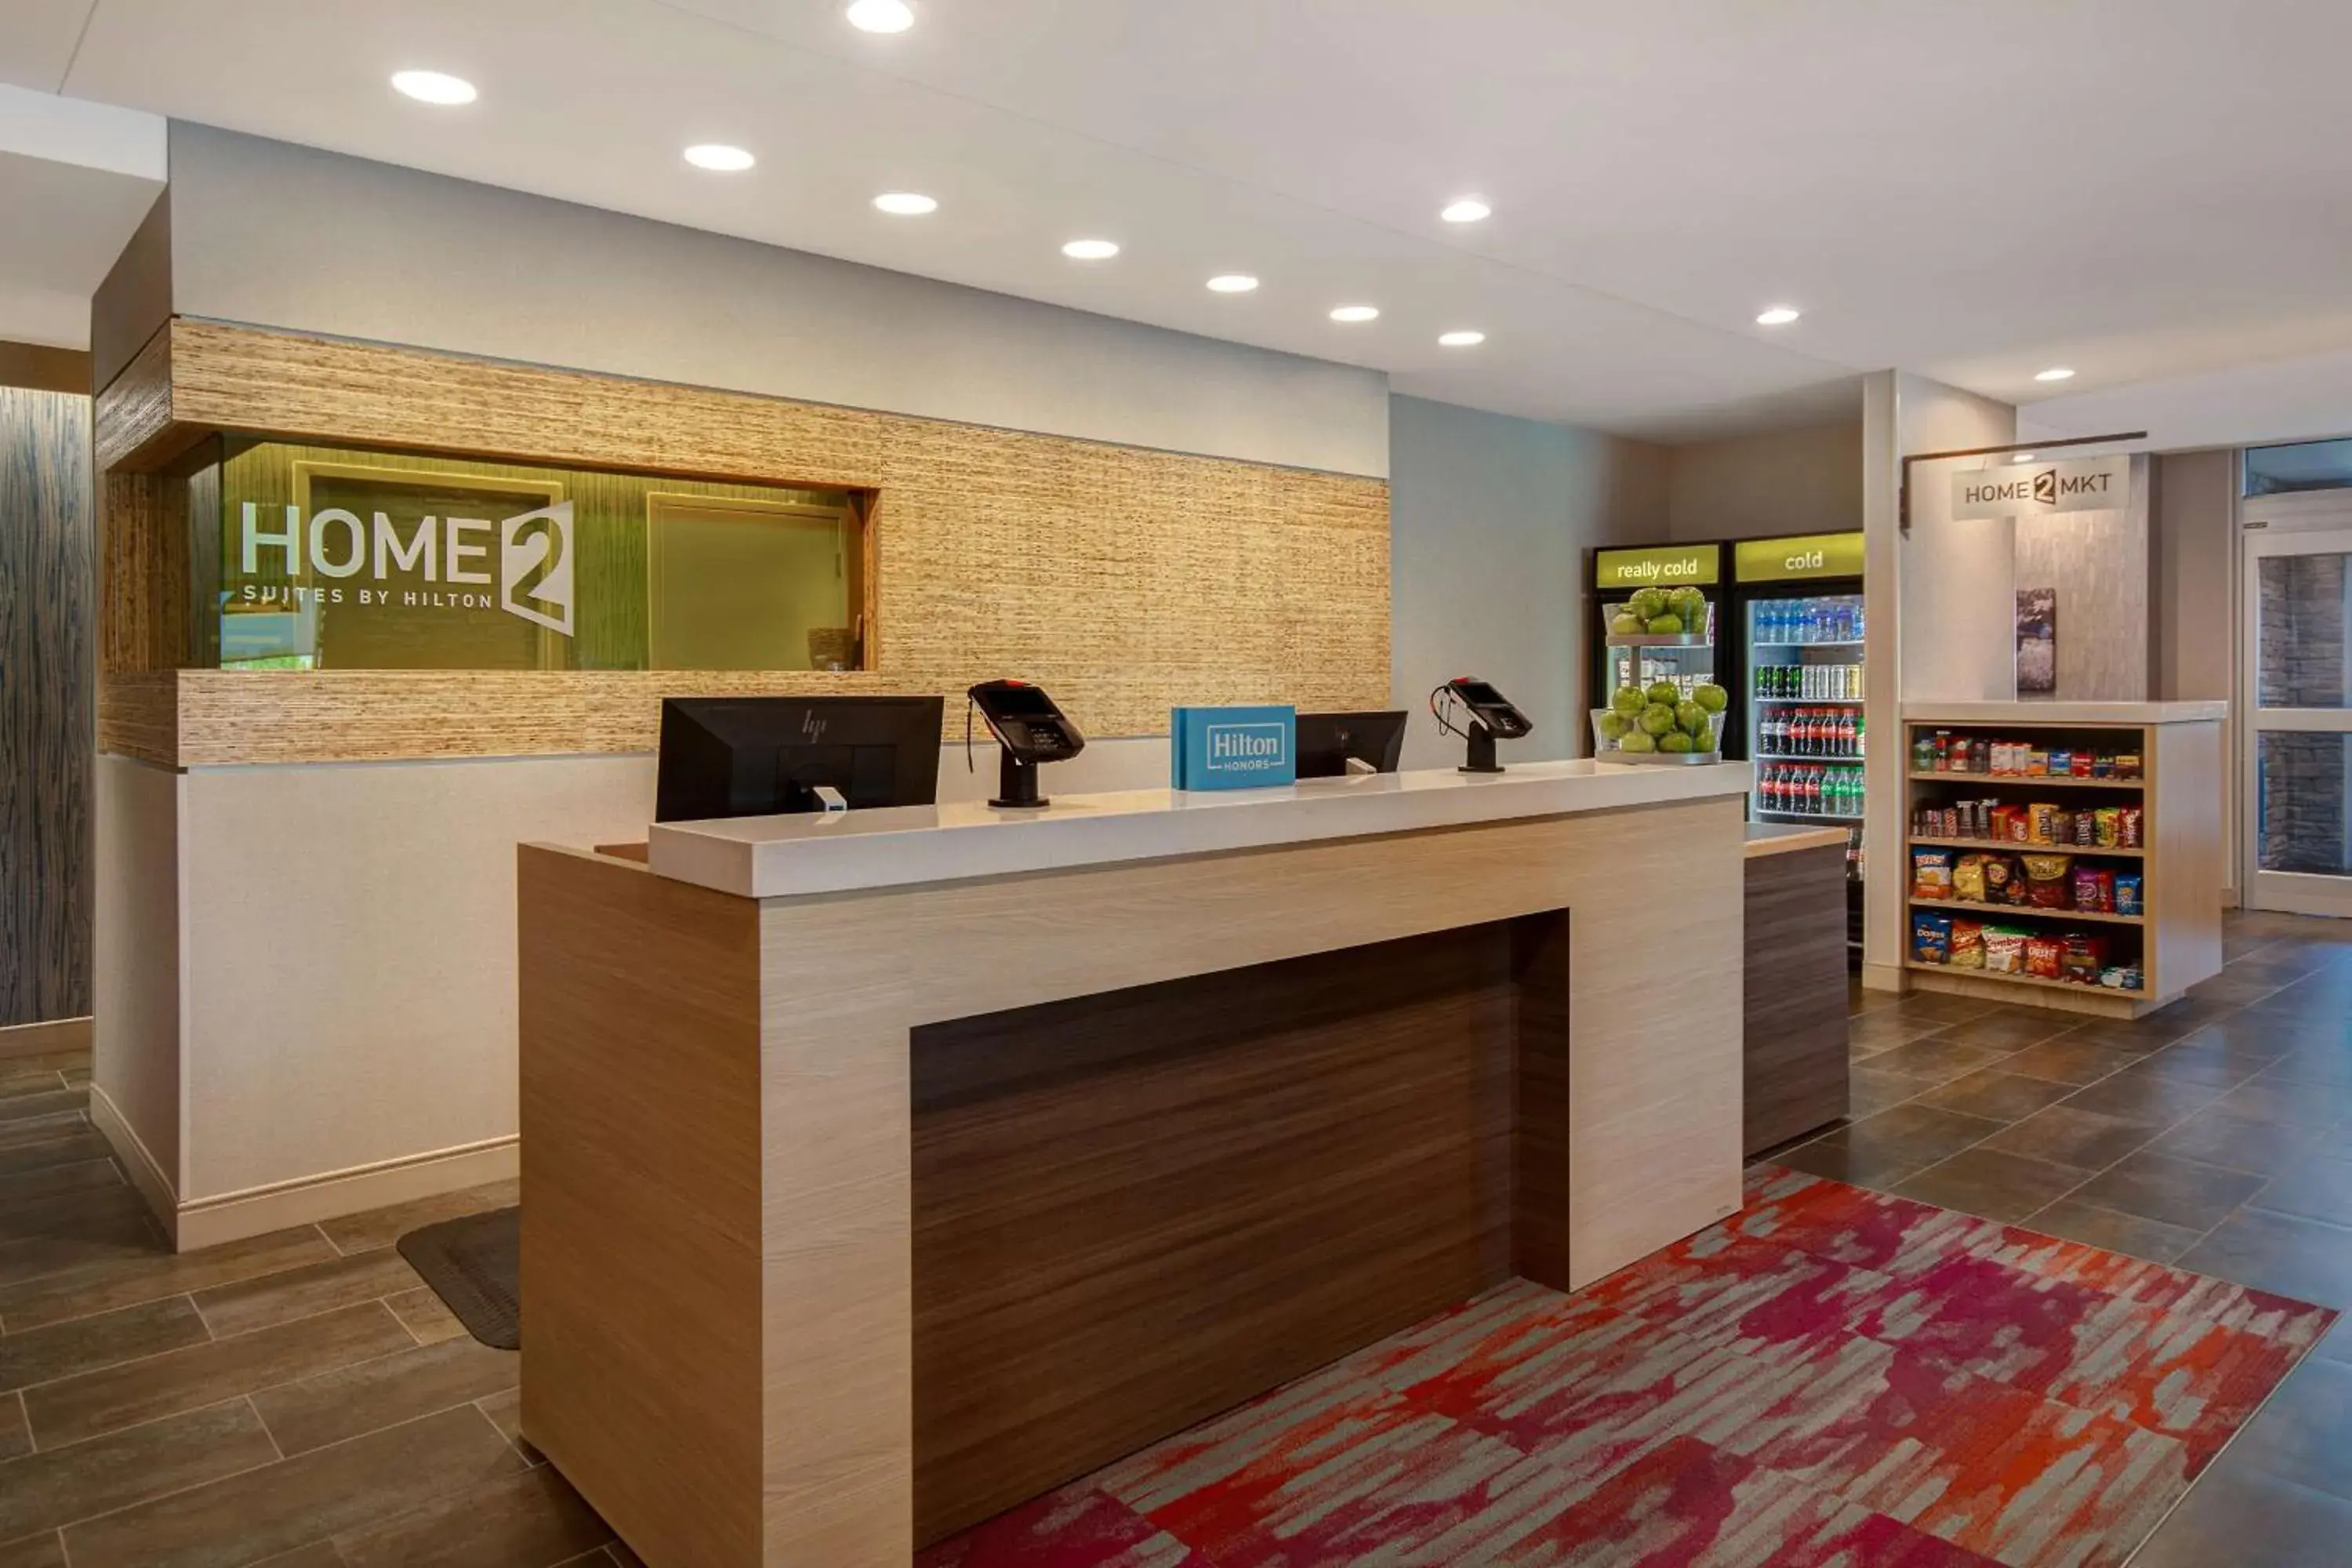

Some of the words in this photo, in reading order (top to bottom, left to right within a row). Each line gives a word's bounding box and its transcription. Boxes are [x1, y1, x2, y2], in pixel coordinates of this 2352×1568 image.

[1617, 560, 1661, 579] really
[1664, 558, 1697, 576] cold
[1784, 551, 1824, 571] cold
[243, 585, 343, 604] SUITES
[359, 590, 388, 606] BY
[404, 592, 494, 608] HILTON
[1214, 733, 1278, 757] Hilton
[1225, 760, 1269, 771] HONORS
